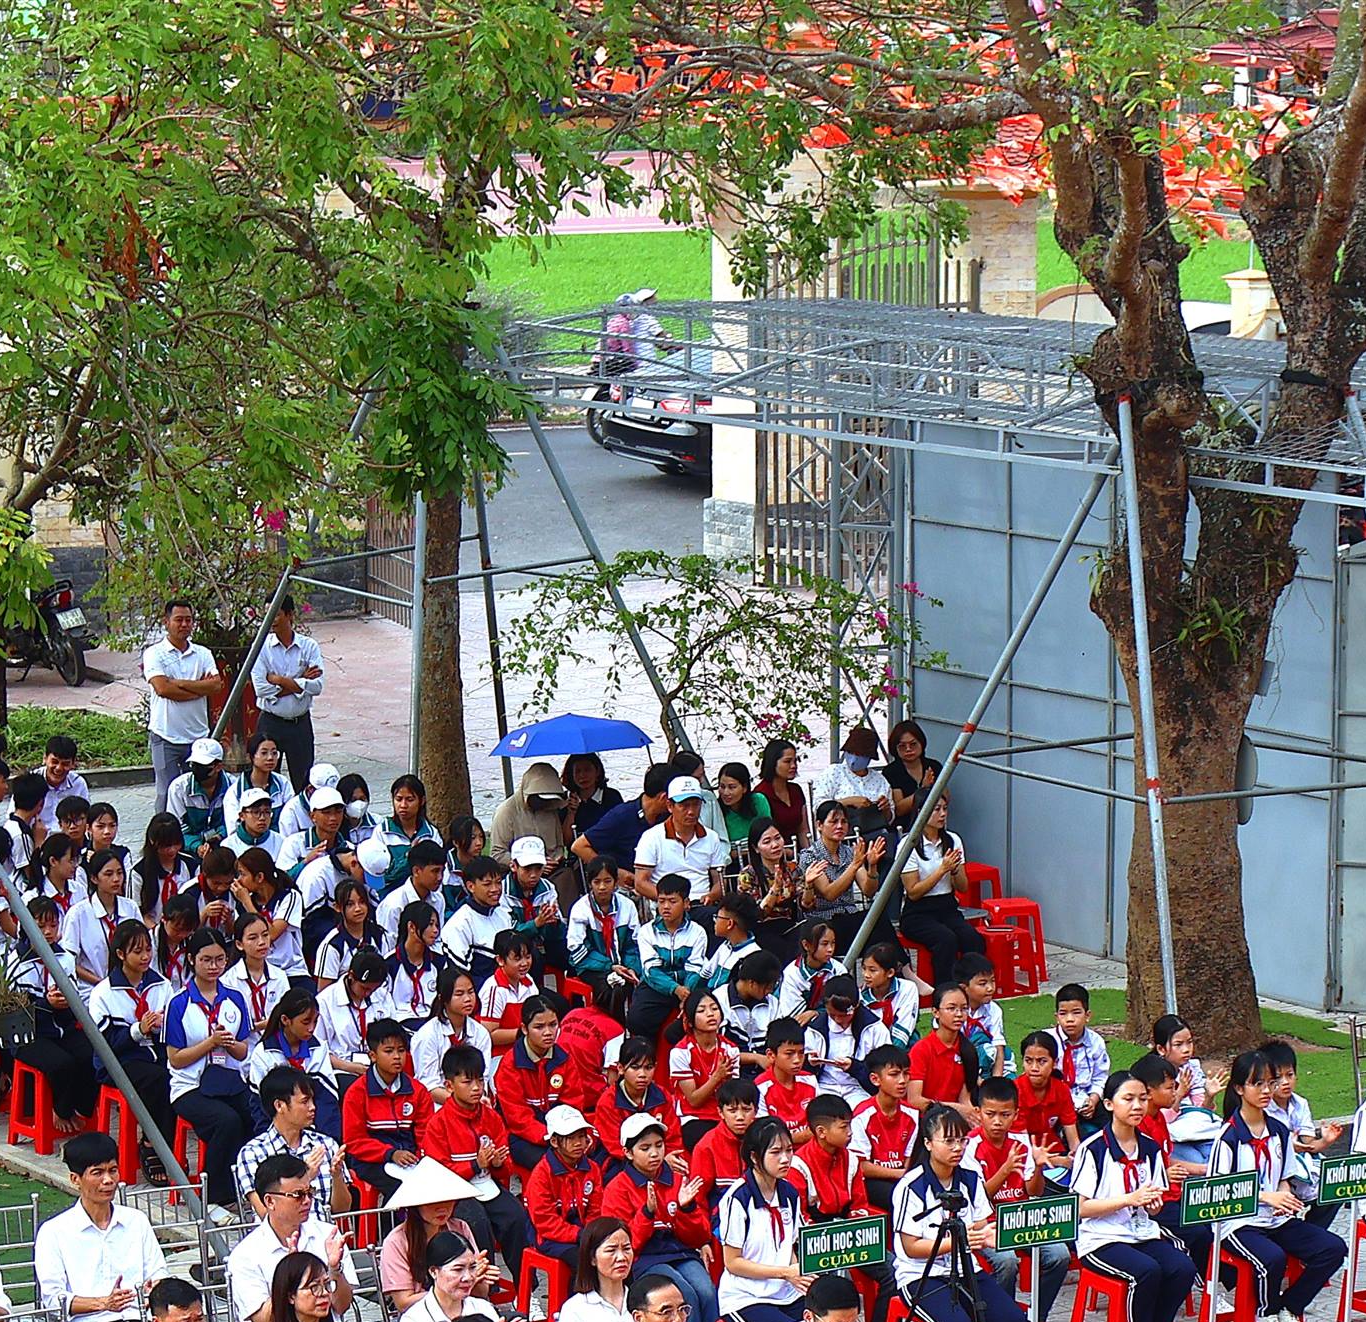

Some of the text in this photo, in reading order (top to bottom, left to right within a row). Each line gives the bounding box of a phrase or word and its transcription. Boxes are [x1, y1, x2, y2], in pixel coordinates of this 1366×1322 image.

[1326, 1160, 1348, 1184] KHỐI
[1189, 1180, 1253, 1206] KHỐI HỌC SINH
[1003, 1204, 1072, 1230] KHỐI HỌC SINH
[1199, 1203, 1243, 1219] CỤM 3
[806, 1226, 879, 1255] KHỐI HỌC SINH
[1014, 1228, 1061, 1244] CỤM 4
[819, 1251, 868, 1268] CỤM 5
